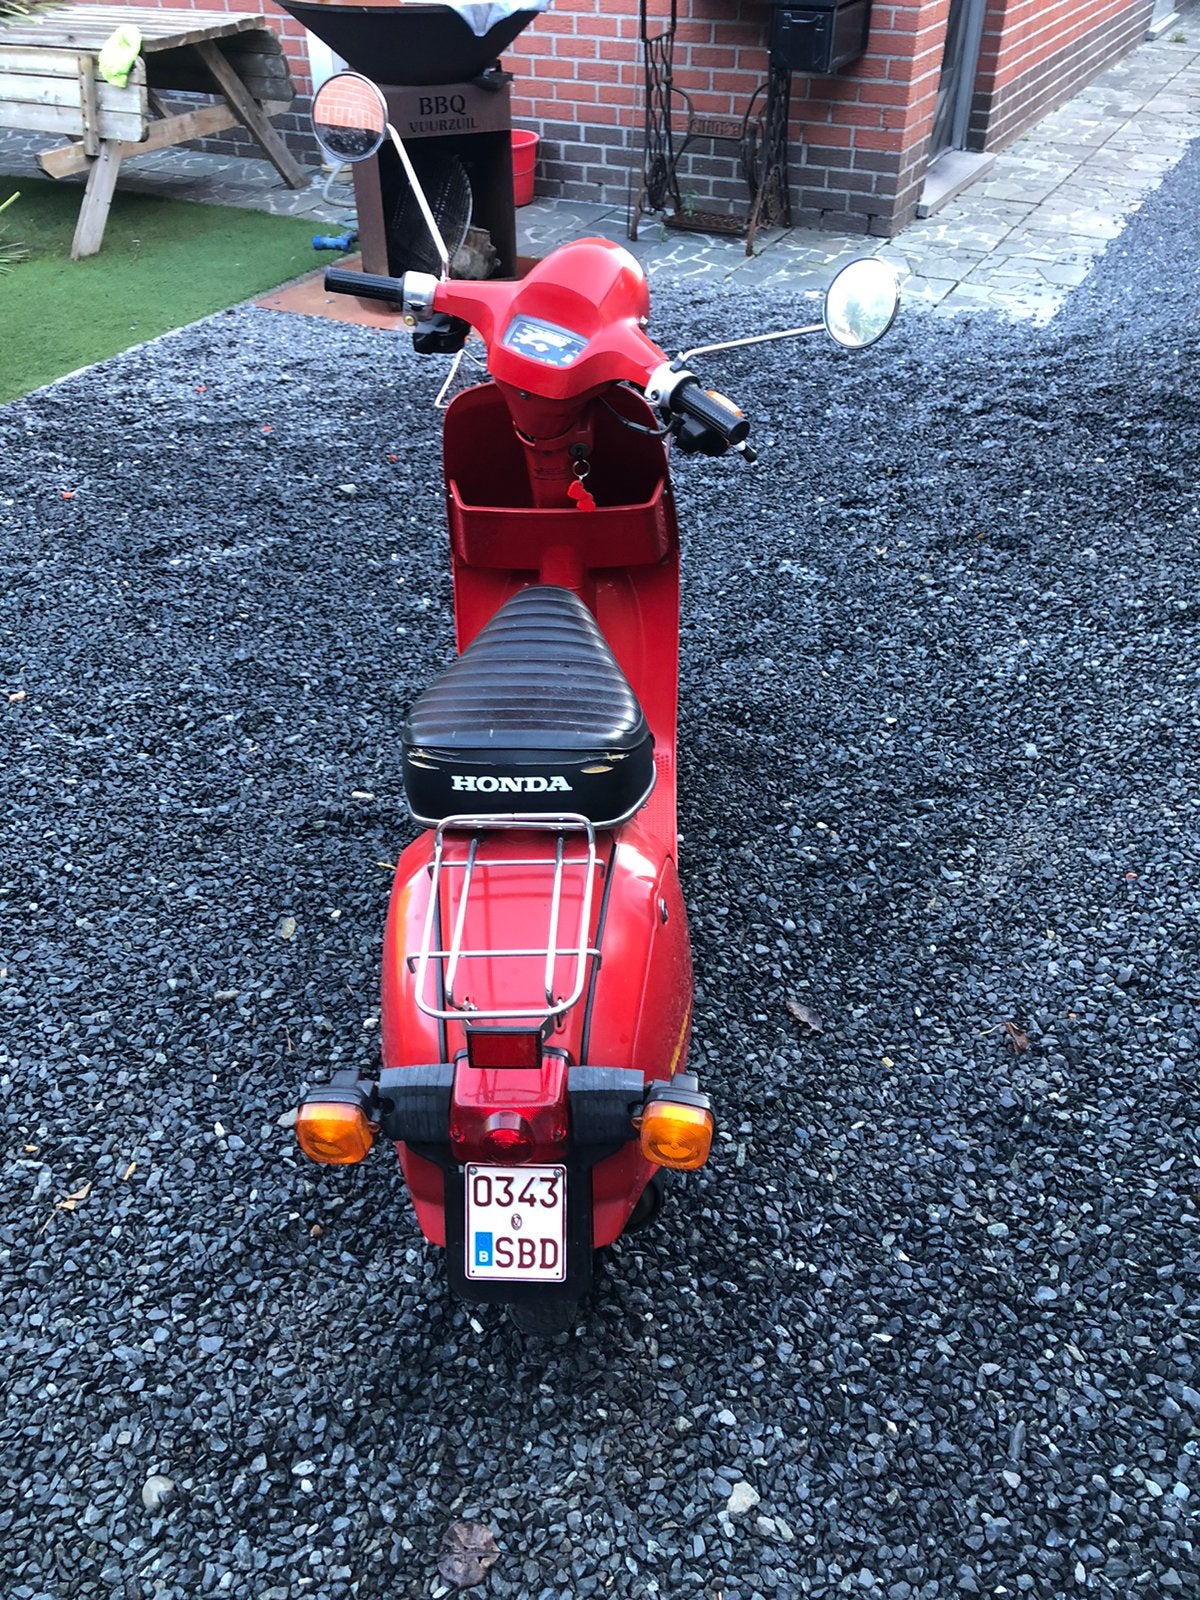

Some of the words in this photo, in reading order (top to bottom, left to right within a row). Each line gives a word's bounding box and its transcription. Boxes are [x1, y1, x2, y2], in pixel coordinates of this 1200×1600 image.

[419, 94, 466, 116] BBQ
[409, 117, 480, 133] VUURZUIL
[451, 775, 573, 792] HONDA
[473, 1175, 558, 1208] 0343
[478, 1250, 489, 1263] B
[495, 1236, 558, 1269] SBD
